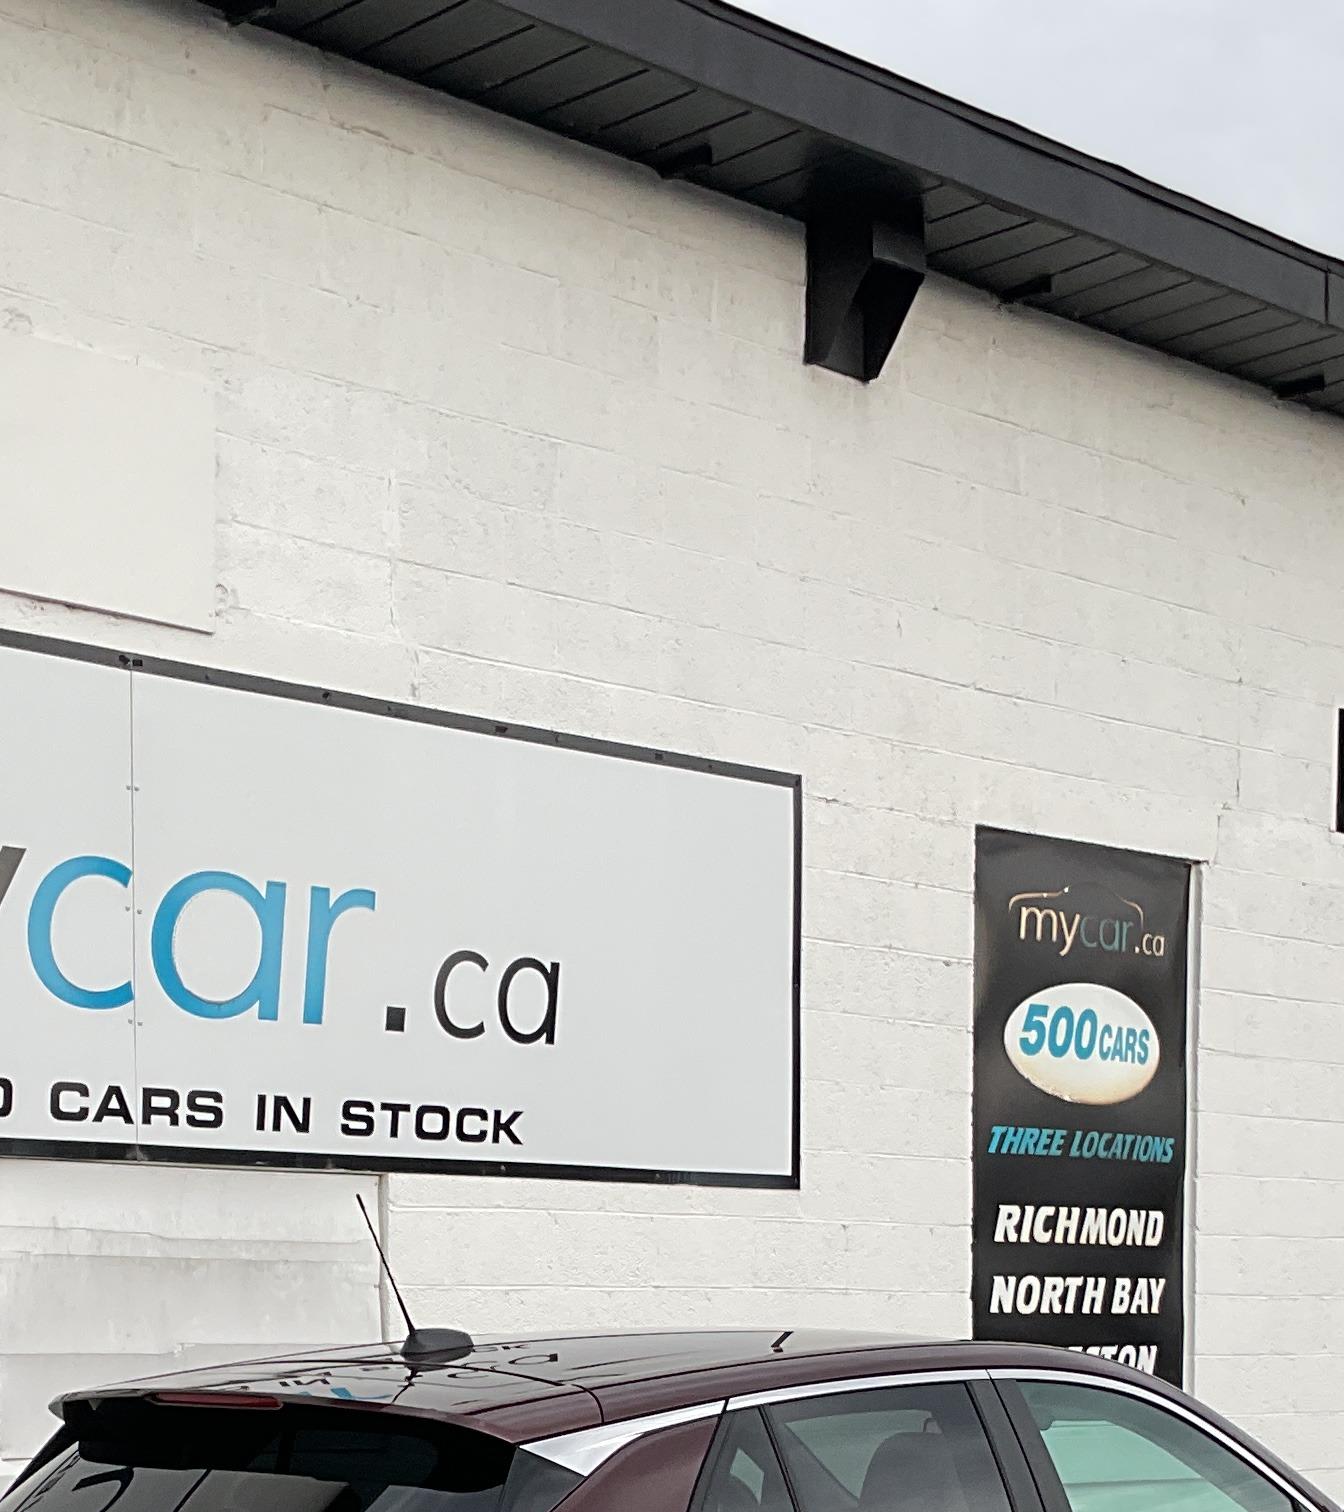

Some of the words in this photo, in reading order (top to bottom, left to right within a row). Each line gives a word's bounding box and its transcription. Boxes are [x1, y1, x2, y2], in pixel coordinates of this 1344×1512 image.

[1018, 905, 1165, 957] mycar.ca
[1018, 1002, 1098, 1060] 500
[1099, 1023, 1150, 1066] CARS
[49, 1080, 224, 1130] CARS
[255, 1093, 312, 1134] IN
[339, 1098, 524, 1146] STOCK
[987, 1125, 1067, 1156] THREE
[1069, 1130, 1175, 1164] LOCATIONS
[994, 1204, 1164, 1247] RICHMOND
[989, 1275, 1106, 1315] NORTH
[1111, 1276, 1166, 1315] BAY
